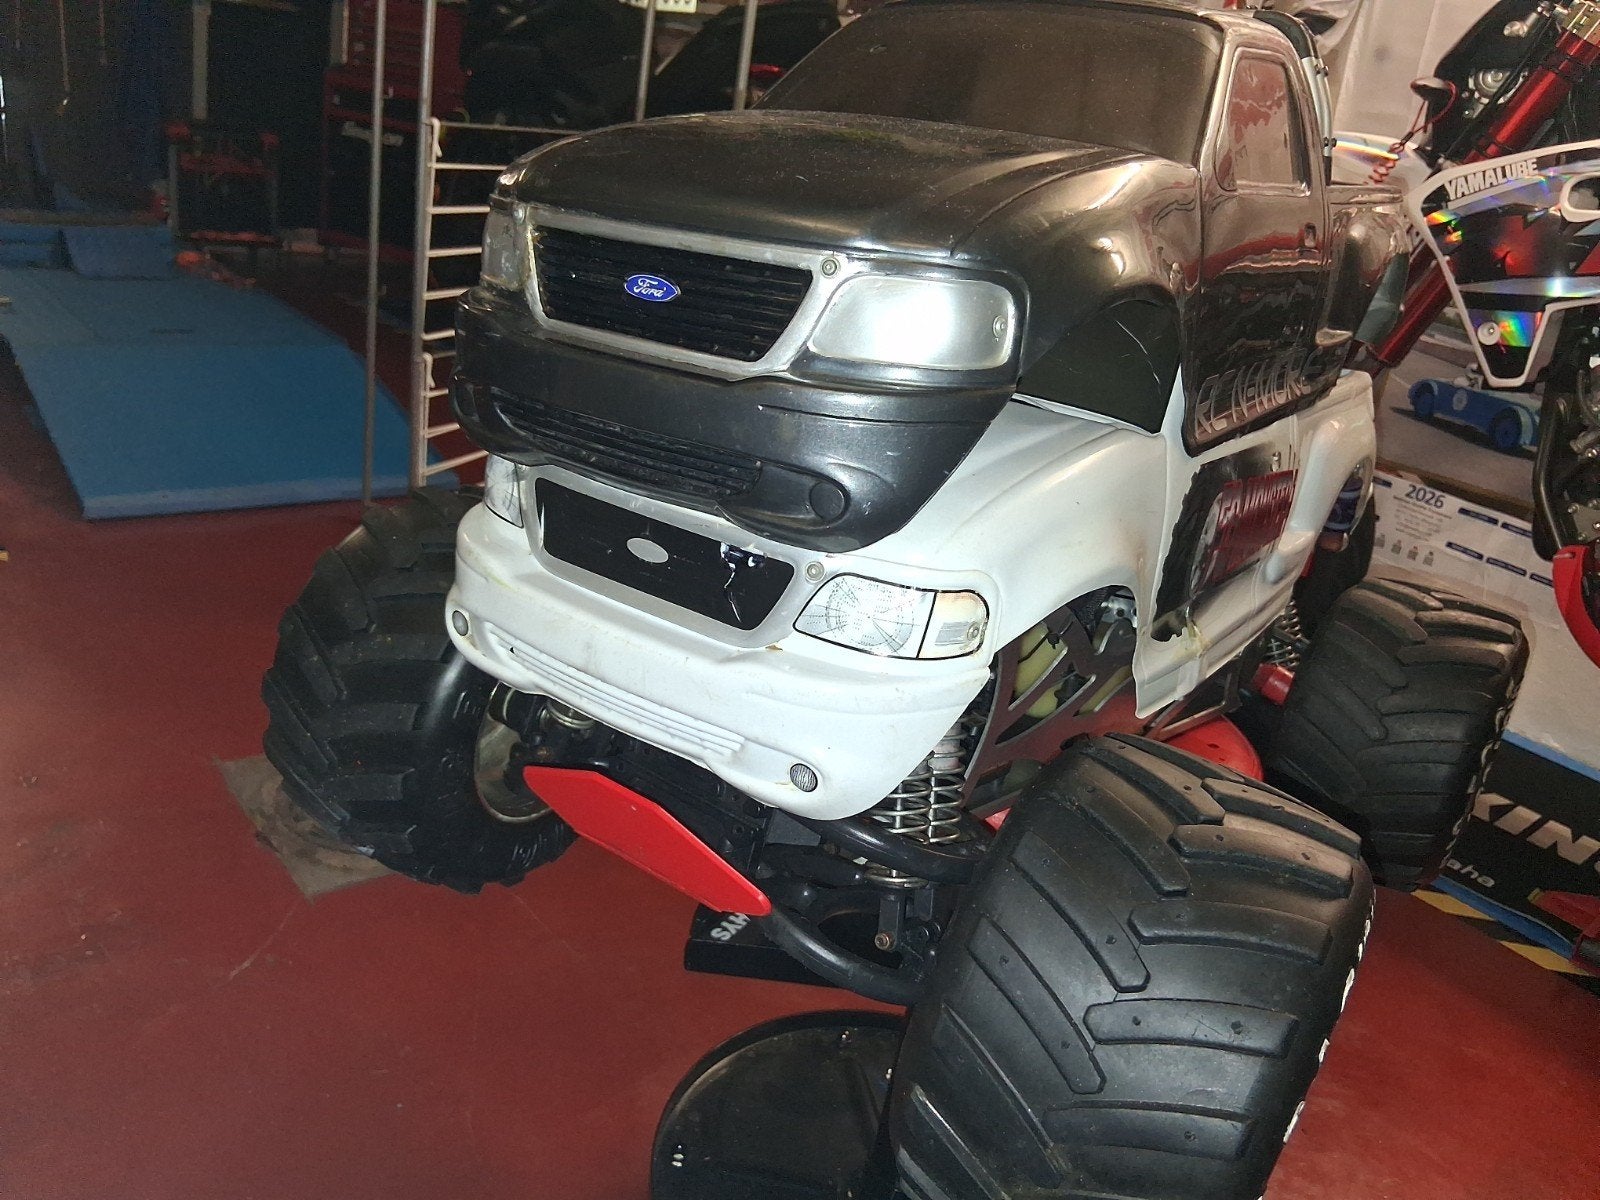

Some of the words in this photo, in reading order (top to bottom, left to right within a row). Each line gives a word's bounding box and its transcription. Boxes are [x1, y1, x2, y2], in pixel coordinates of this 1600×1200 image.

[1443, 158, 1539, 201] YAMALUBE
[633, 277, 667, 298] Ford
[1405, 483, 1446, 509] 2026
